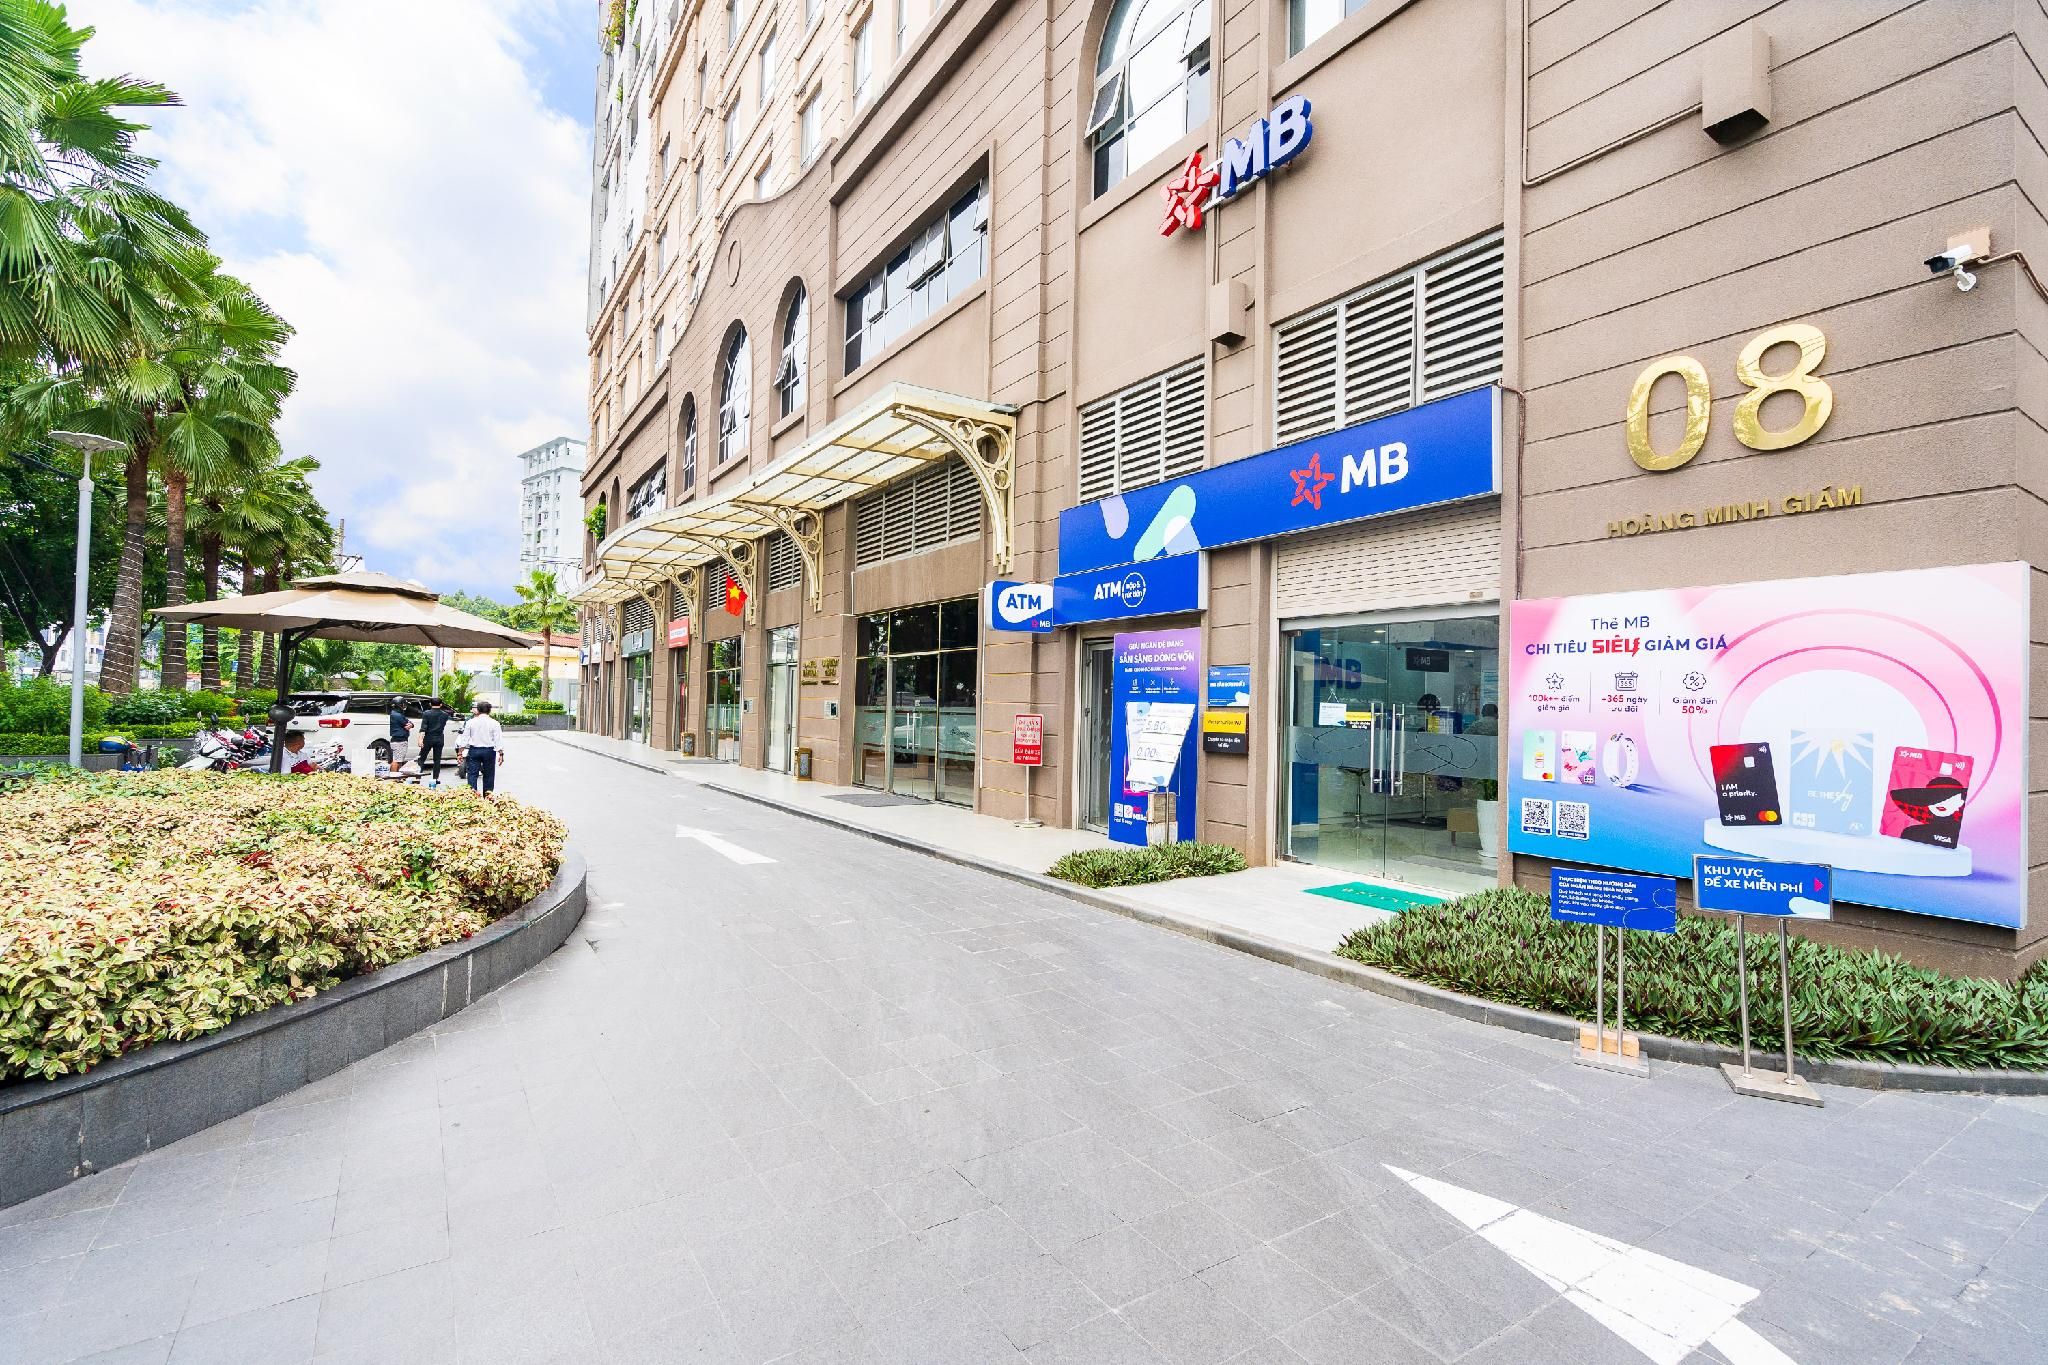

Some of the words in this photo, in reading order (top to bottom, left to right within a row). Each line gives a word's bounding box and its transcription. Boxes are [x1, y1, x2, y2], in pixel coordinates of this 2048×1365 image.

[1219, 94, 1313, 198] MB
[1626, 323, 1833, 471] 08
[1340, 442, 1409, 494] MB
[1607, 512, 1695, 538] HOÀNG
[1703, 499, 1771, 525] MINH
[1781, 480, 1862, 515] GIÁM
[1094, 581, 1122, 600] ATM
[1006, 593, 1042, 610] ATM
[1039, 620, 1051, 628] MB
[1591, 617, 1619, 630] Thẻ
[1624, 616, 1650, 629] MB
[1525, 643, 1550, 656] CHI
[1554, 639, 1587, 654] TIÊU
[1644, 635, 1690, 651] GIẢM
[1696, 634, 1729, 650] GIÁ
[1626, 695, 1648, 705] ngày
[1681, 706, 1708, 714] 50%
[1933, 834, 1951, 843] VISA
[1703, 864, 1731, 876] KHU
[1733, 866, 1764, 879] VỰC
[1704, 876, 1722, 887] ĐỂ
[1723, 879, 1741, 889] XE
[1744, 877, 1777, 892] MIỄN
[1780, 881, 1803, 893] PHÍ
